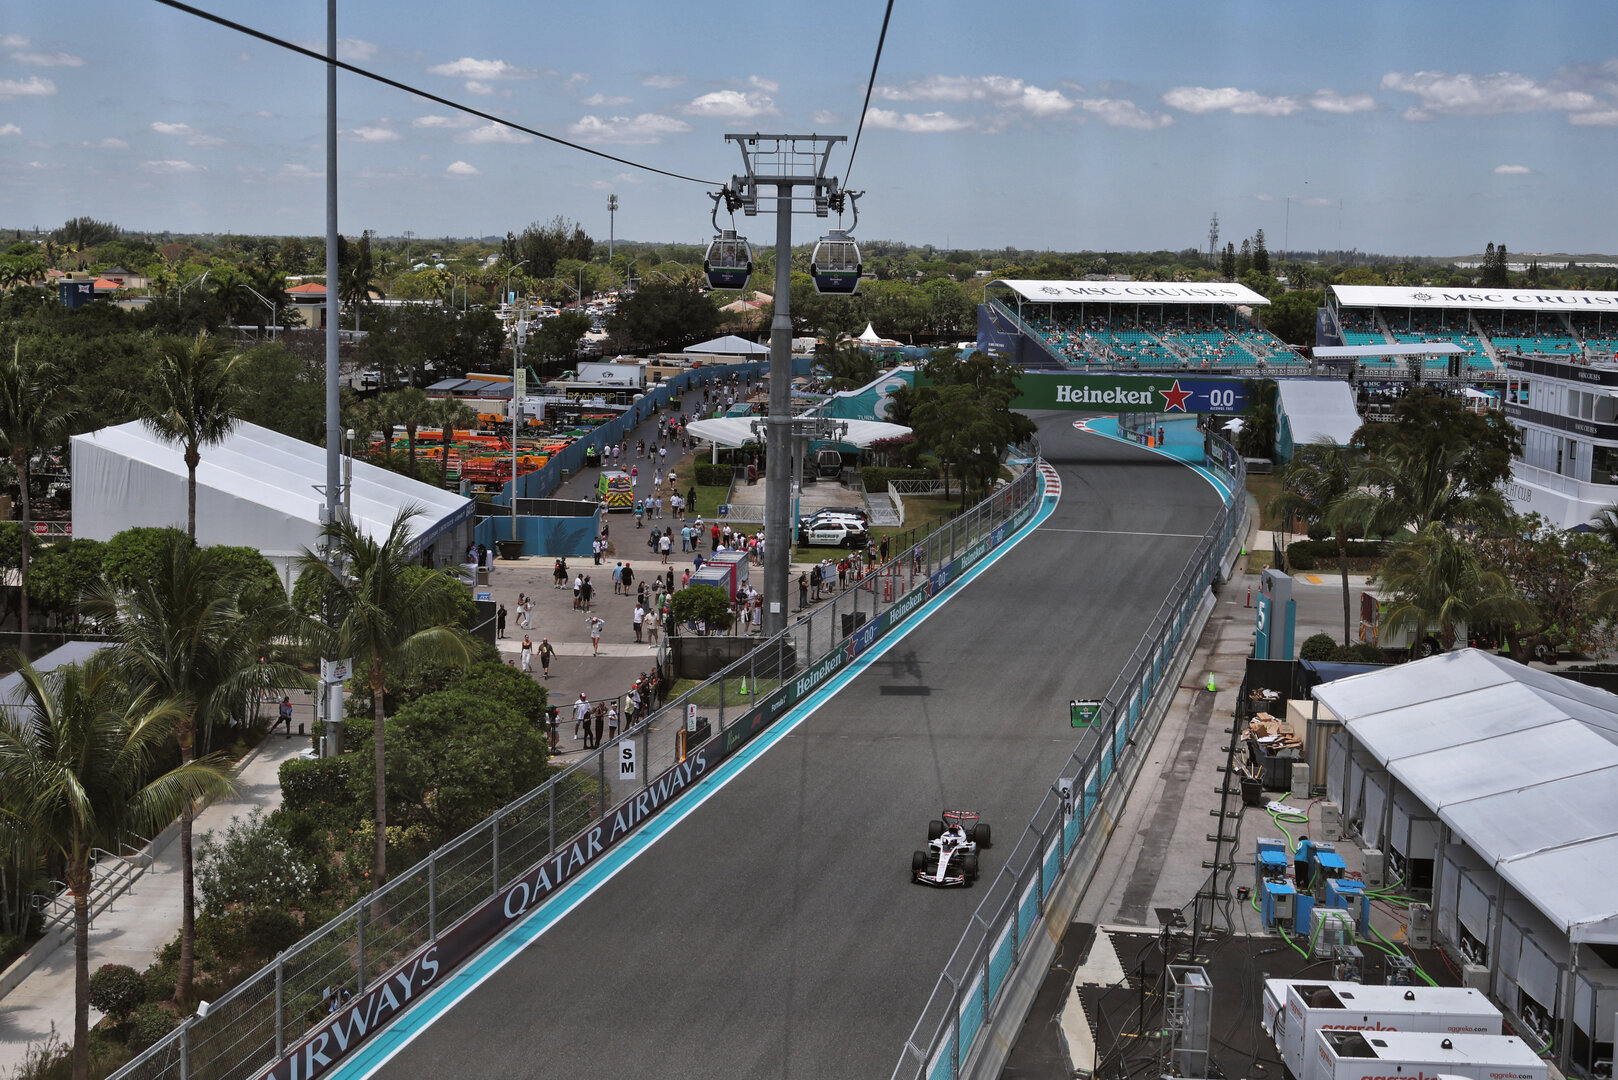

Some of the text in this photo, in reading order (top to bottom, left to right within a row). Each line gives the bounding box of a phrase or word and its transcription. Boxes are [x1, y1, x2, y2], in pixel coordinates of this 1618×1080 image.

[1066, 287, 1238, 297] MSC CRUISES
[1442, 293, 1618, 305] MSC CRUIS
[1056, 385, 1153, 404] Heineken
[1210, 389, 1235, 407] 0.0
[890, 592, 922, 625] Heineken
[1258, 601, 1266, 630] 5
[796, 652, 842, 698] Heineken
[622, 748, 632, 760] S
[621, 762, 634, 774] M
[504, 748, 706, 919] QATAR AIRWAYS
[266, 946, 439, 1080] IRWAYS
[1490, 1072, 1532, 1080] aggreko.com
